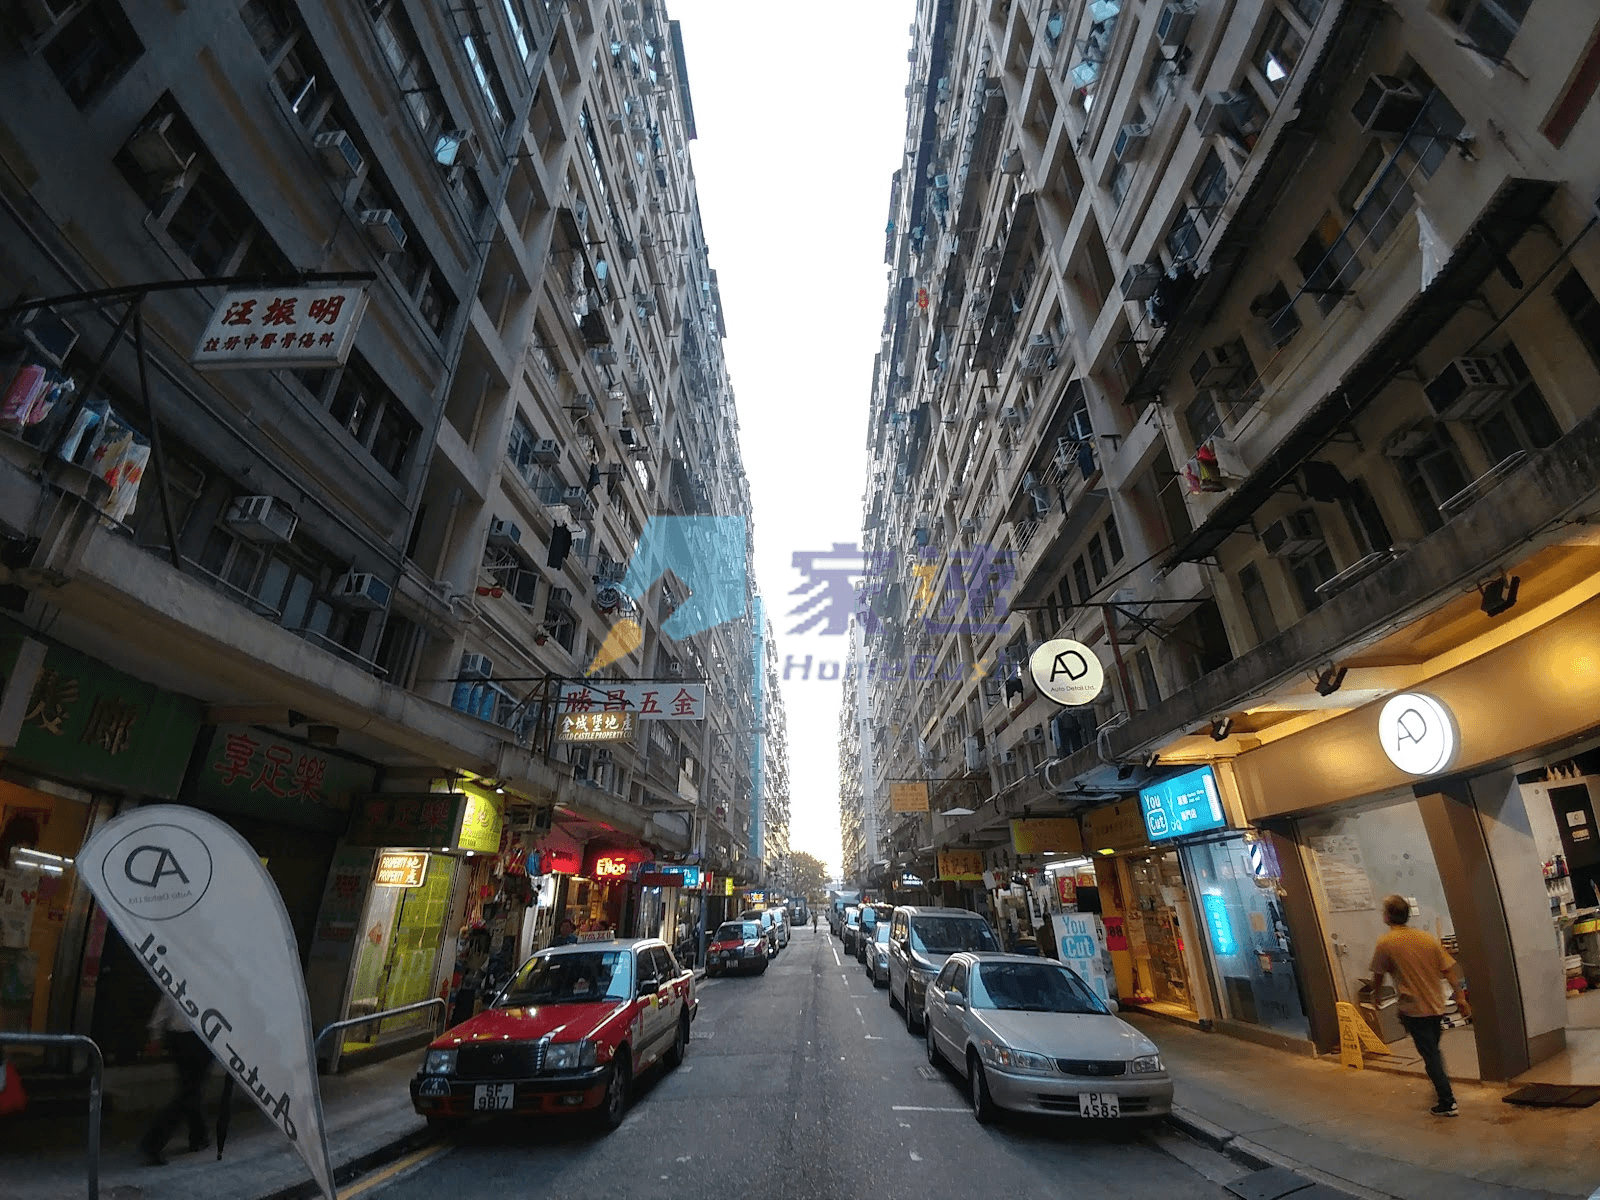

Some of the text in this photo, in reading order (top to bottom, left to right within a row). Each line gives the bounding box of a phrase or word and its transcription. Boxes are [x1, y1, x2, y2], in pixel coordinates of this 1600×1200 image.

[221, 295, 345, 326] 汪振明
[565, 687, 700, 714] 勝昌五金
[561, 712, 633, 733] 金城堡地產
[559, 733, 573, 741] GOLD
[574, 732, 595, 740] CASTLE
[595, 731, 624, 740] PROPERTY
[214, 733, 327, 800] 享足樂
[1144, 795, 1161, 810] You
[1149, 815, 1165, 831] Cut
[381, 856, 408, 869] PROPERTY
[378, 869, 405, 883] PROPERTY
[1062, 916, 1087, 934] You
[1065, 937, 1093, 957] Cut
[1089, 1092, 1109, 1106] PL
[1082, 1105, 1119, 1118] 4585
